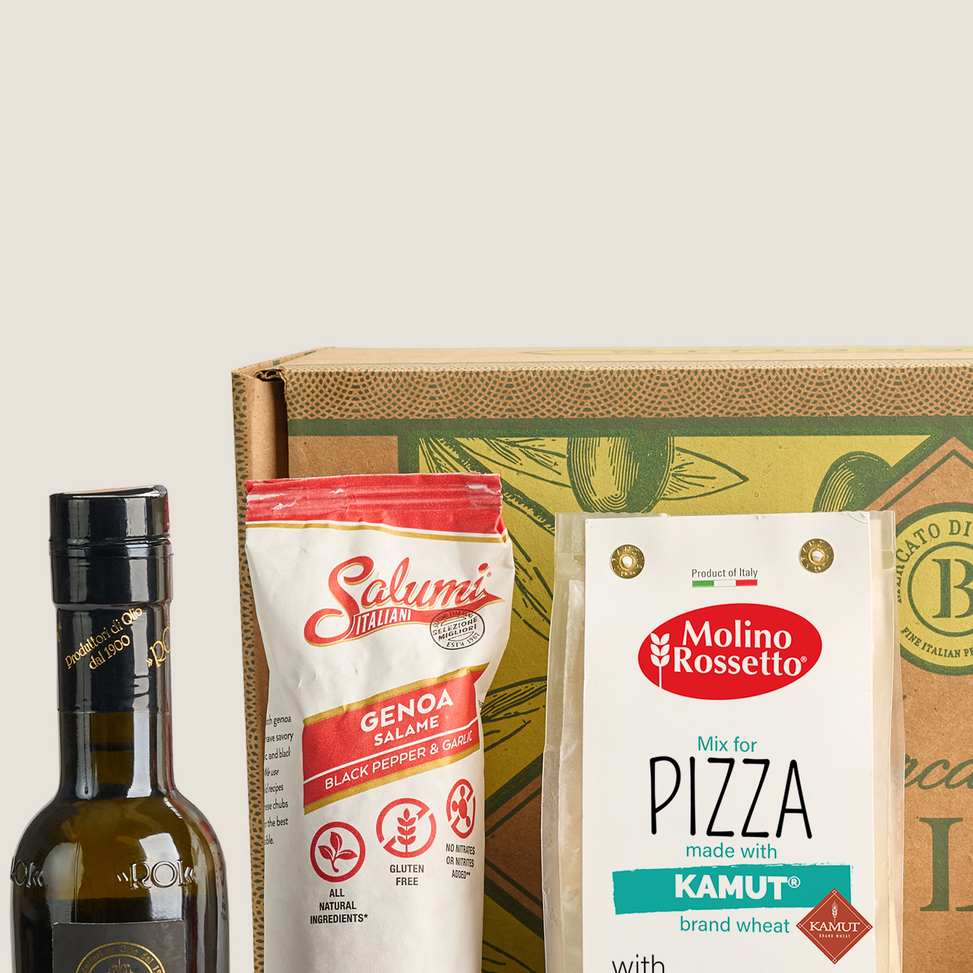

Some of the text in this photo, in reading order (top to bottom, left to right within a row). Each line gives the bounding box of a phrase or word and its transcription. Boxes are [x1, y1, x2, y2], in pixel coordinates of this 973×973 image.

[895, 522, 941, 604] CATO
[948, 519, 972, 537] DI
[691, 568, 758, 579] Product of Italy
[303, 555, 505, 647] Salumi
[354, 607, 412, 636] ITALIANI
[432, 615, 478, 636] SELEZIONE
[64, 606, 143, 670] Produttori di Olio
[438, 623, 477, 641] MIGLIORI
[682, 619, 793, 649] Molino
[900, 626, 923, 647] FINE
[921, 643, 961, 658] ITALIAN
[89, 634, 131, 671] dal 1900
[360, 688, 454, 733] GENOA
[273, 715, 292, 728] genoa
[275, 733, 295, 742] savory
[374, 715, 440, 747] SALAME
[697, 735, 758, 752] Mix for
[268, 748, 278, 760] and
[325, 730, 474, 790] BLACK PEPPER & GARLIC
[649, 755, 813, 839] PIZZA
[445, 843, 455, 853] NO
[686, 842, 778, 859] made with
[389, 864, 425, 874] GLUTEN
[446, 855, 454, 865] OR
[395, 877, 419, 886] FREE
[329, 888, 345, 898] ALL
[319, 901, 357, 911] NATURAL
[680, 916, 790, 934] brand wheat
[809, 921, 861, 932] KAMUT
